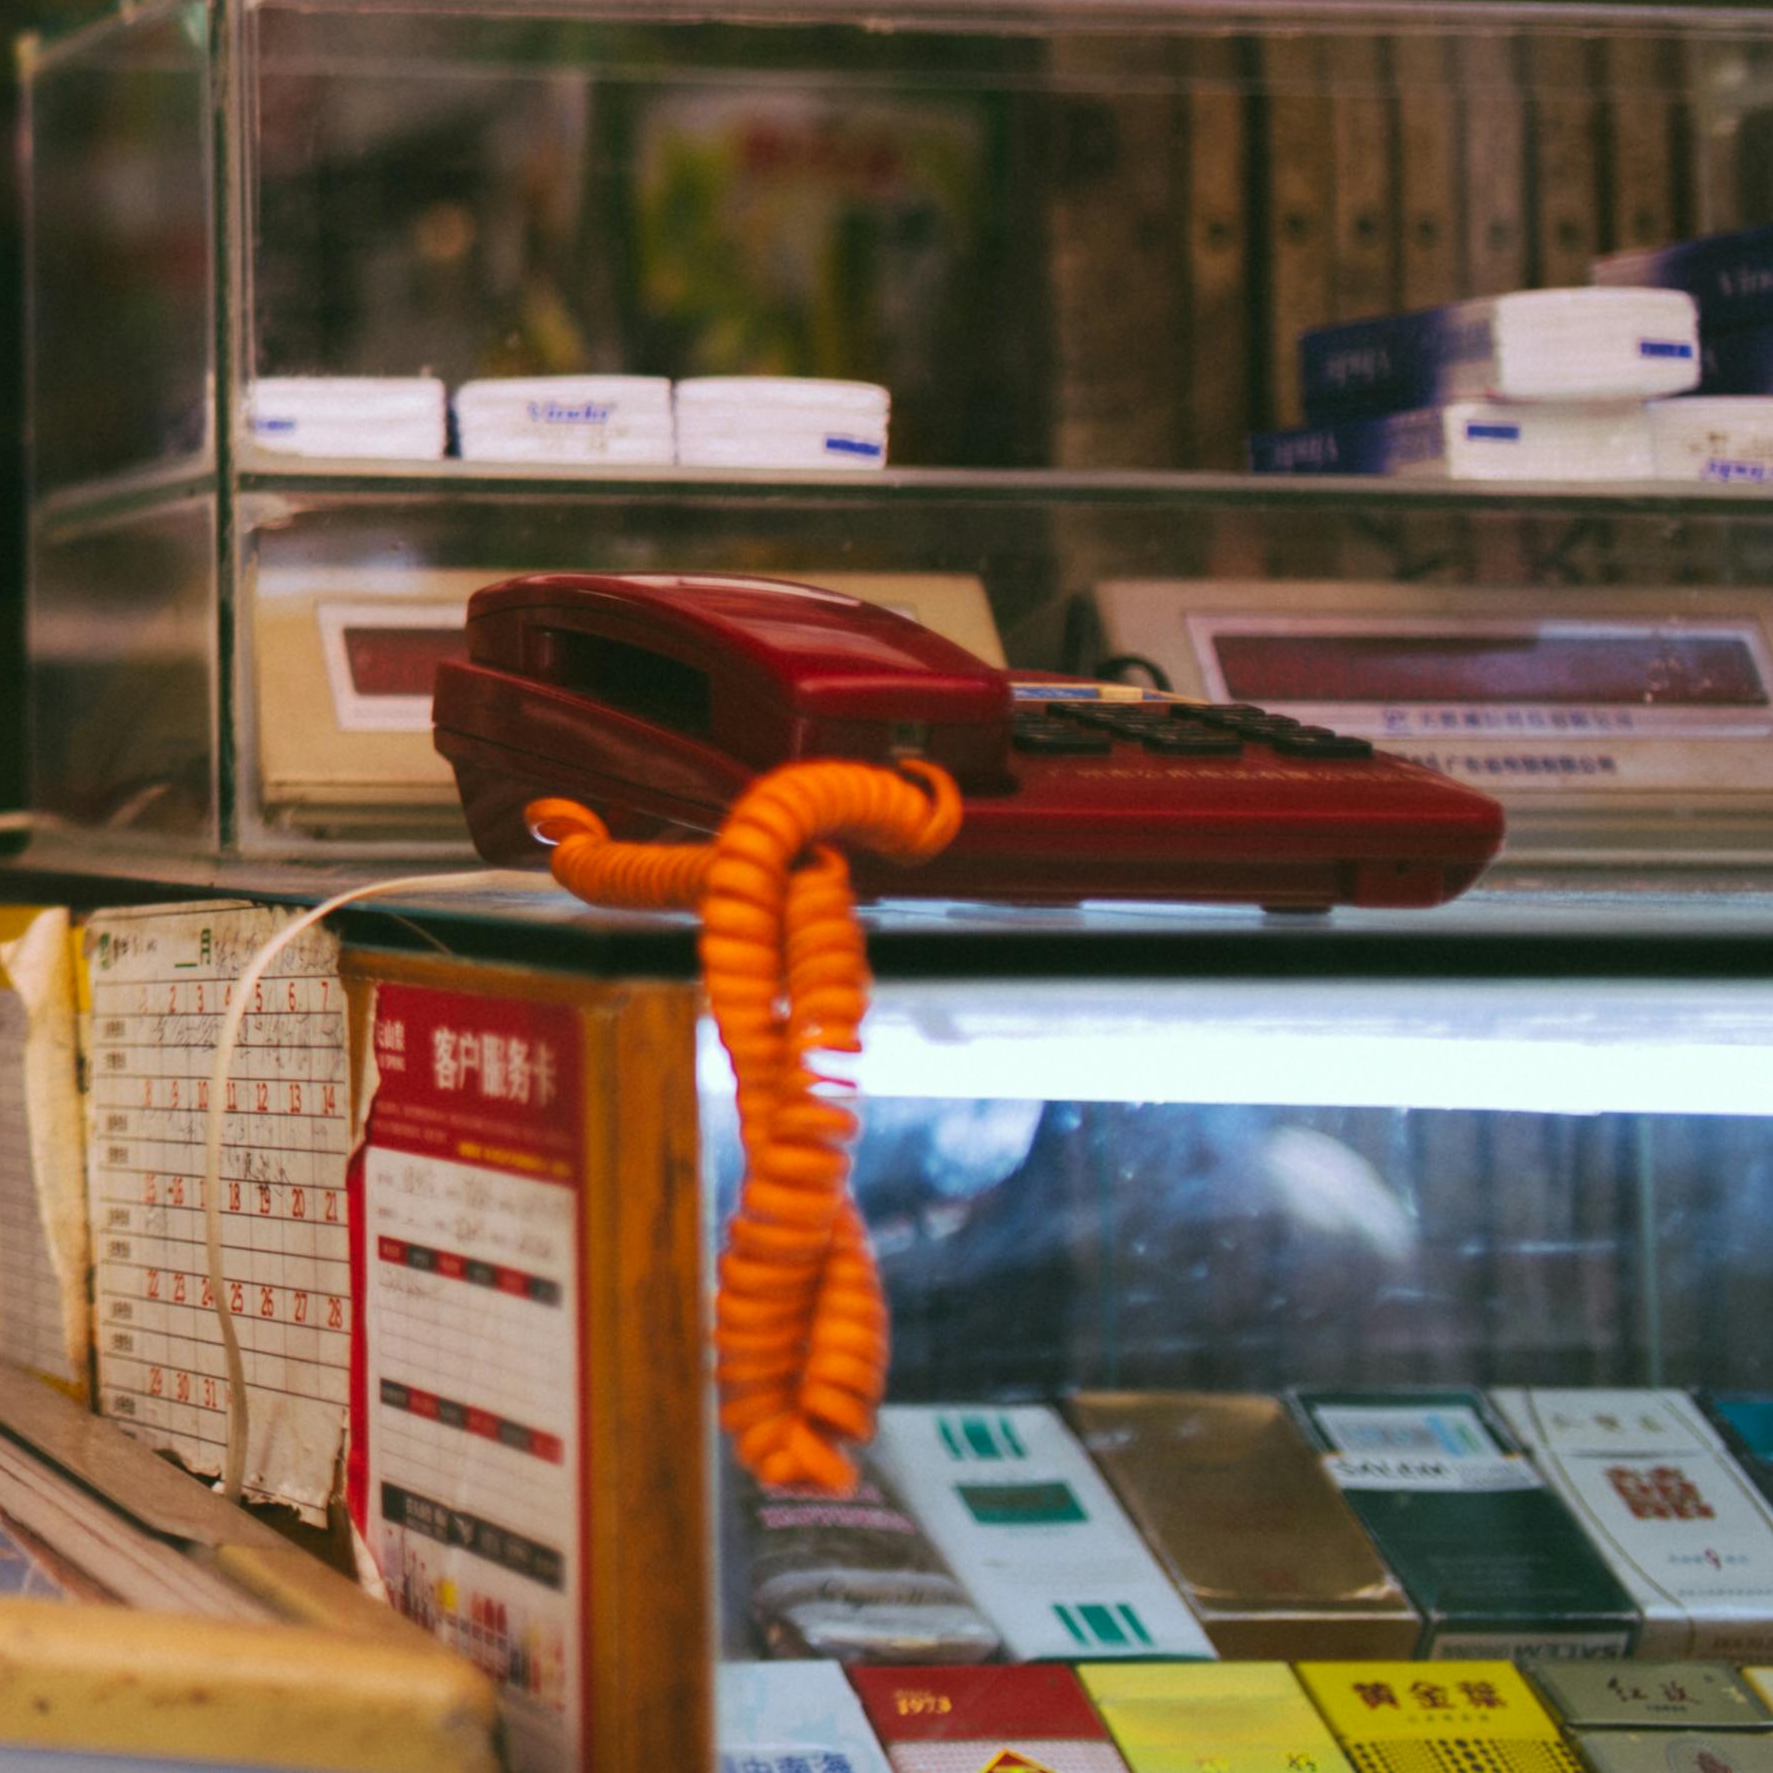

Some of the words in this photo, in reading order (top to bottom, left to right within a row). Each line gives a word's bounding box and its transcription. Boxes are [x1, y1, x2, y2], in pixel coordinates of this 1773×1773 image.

[168, 984, 177, 1014] 2
[196, 983, 204, 1014] 3
[254, 982, 264, 1013] 5
[287, 981, 297, 1012] 6
[320, 980, 329, 1012] 7
[197, 1080, 209, 1109] 10
[225, 1081, 238, 1110] 11
[256, 1083, 268, 1112] 12
[288, 1083, 302, 1113] 13
[322, 1085, 336, 1115] 14
[228, 1181, 241, 1211] 18
[291, 1187, 305, 1218] 20
[324, 1191, 338, 1222] 21
[173, 1272, 186, 1302] 23
[230, 1282, 244, 1313] 25
[260, 1286, 274, 1317] 26
[294, 1290, 308, 1323] 27
[327, 1296, 343, 1328] 28
[176, 1371, 190, 1402] 30
[204, 1377, 217, 1410] 31
